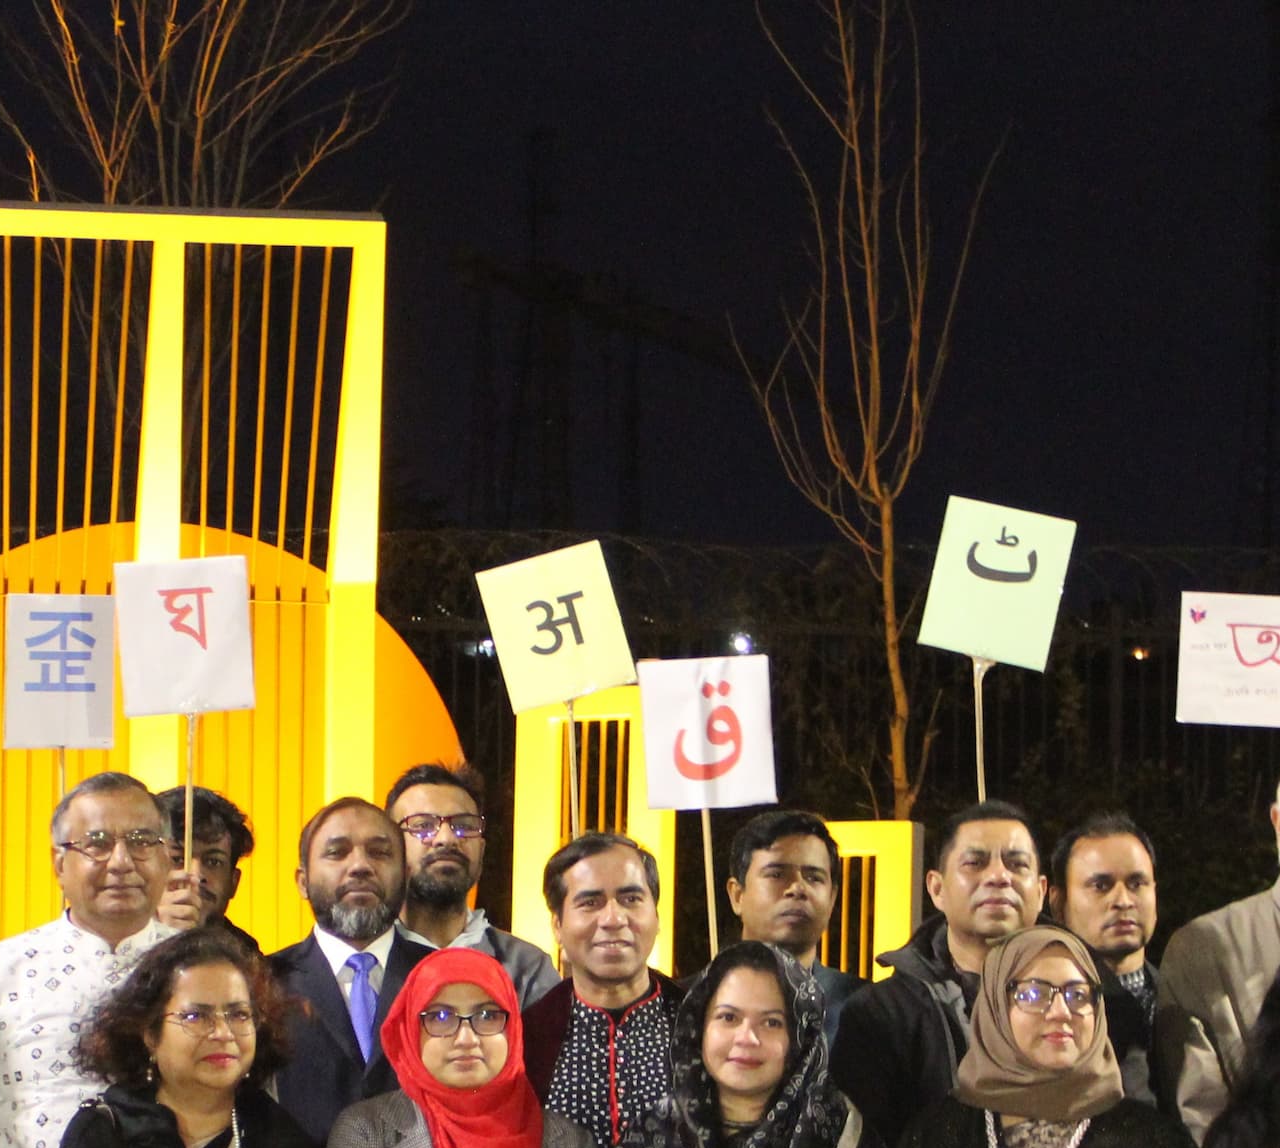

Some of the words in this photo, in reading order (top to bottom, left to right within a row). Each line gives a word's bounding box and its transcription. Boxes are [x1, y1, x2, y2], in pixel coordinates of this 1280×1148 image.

[966, 526, 1037, 583] ٹ
[157, 587, 214, 650] ঘ
[526, 590, 584, 655] अ
[24, 612, 96, 692] 歪
[673, 680, 742, 781] ق
